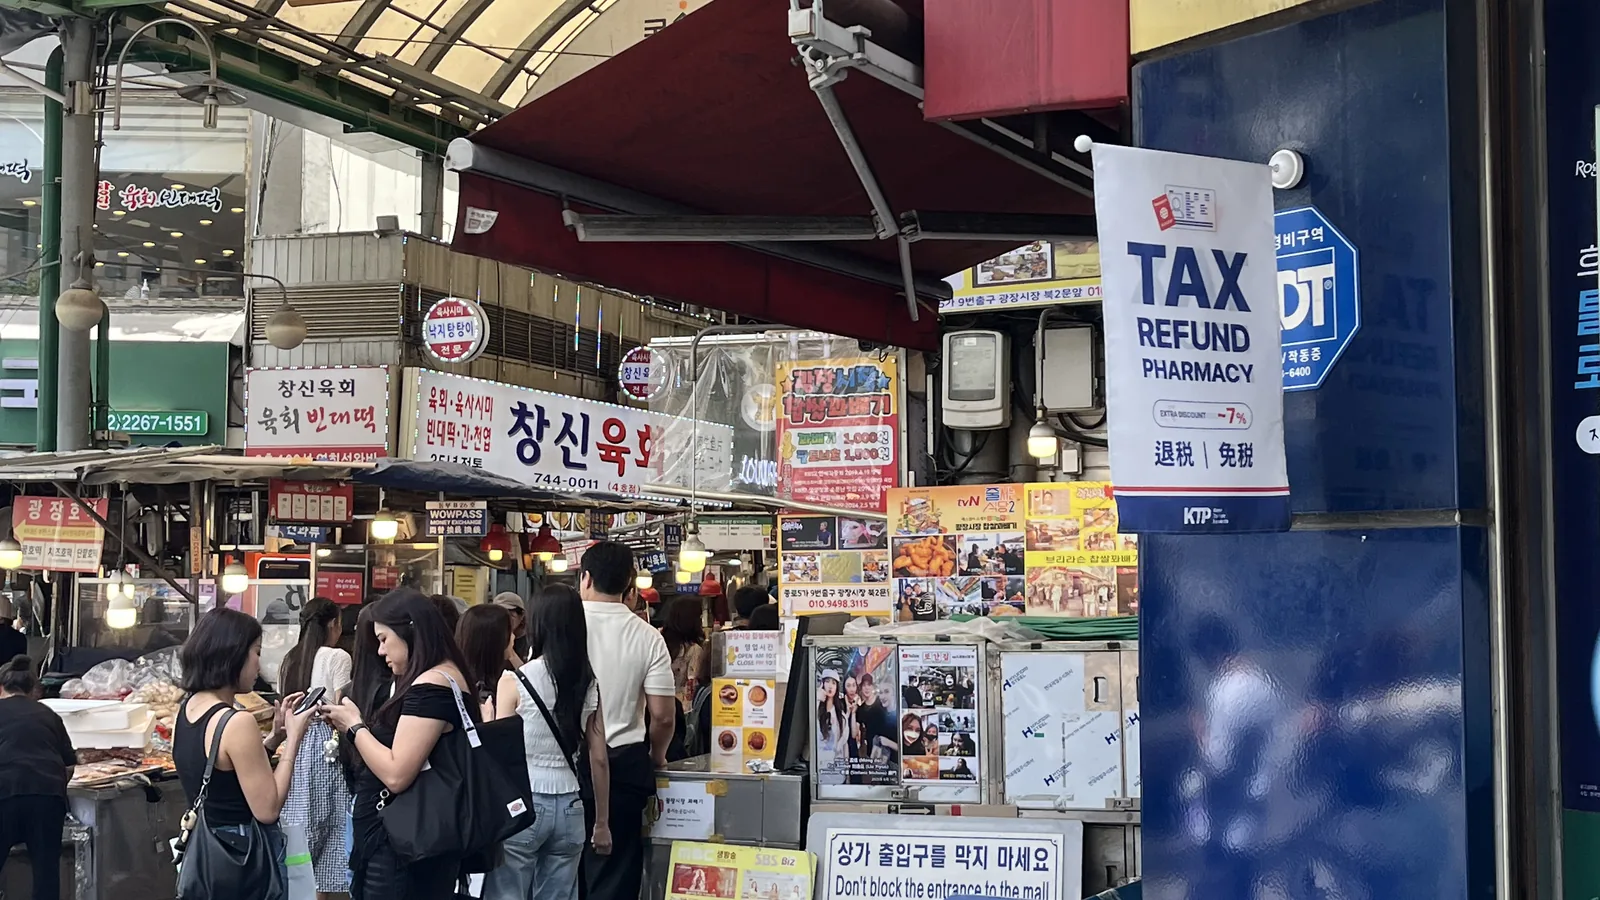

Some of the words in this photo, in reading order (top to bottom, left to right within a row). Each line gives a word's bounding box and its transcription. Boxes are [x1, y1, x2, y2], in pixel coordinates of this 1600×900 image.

[1127, 241, 1251, 313] TAX
[958, 295, 996, 307] 9번출구
[999, 292, 1040, 304] 광장시장
[1044, 288, 1083, 300] 북2문앞
[436, 305, 464, 317] 육사시미
[428, 320, 474, 339] 낙지탕탕이
[1138, 317, 1250, 353] REFUND
[1143, 358, 1253, 384] PHARMACY
[277, 378, 356, 399] 창신육회
[257, 405, 300, 435] 육회
[306, 405, 376, 433] 빈대떡
[1159, 409, 1178, 418] EXTRA
[1178, 411, 1206, 419] DISCOUNT
[1155, 440, 1195, 467] 退税
[1219, 441, 1254, 468] 免税
[533, 472, 599, 489] 744-0011
[607, 481, 641, 494] (4호점)
[957, 495, 980, 507] tvN
[430, 510, 483, 519] WOWPASS
[1183, 506, 1212, 525] KTP
[784, 588, 809, 598] 종로5가
[810, 588, 836, 598] 9번출구
[837, 588, 866, 598] 광장시장
[808, 599, 869, 608] 010.9498.3115
[716, 851, 737, 860] 생방송
[755, 853, 778, 867] SBS
[837, 841, 870, 867] 상가
[878, 843, 946, 869] 출입구를
[955, 844, 988, 870] 막지
[997, 846, 1049, 872] 마세요
[835, 875, 867, 896] Don't
[870, 877, 902, 899] block
[904, 878, 923, 899] the
[927, 881, 983, 900] entrance
[1000, 881, 1021, 899] the
[1023, 881, 1049, 900] mall
